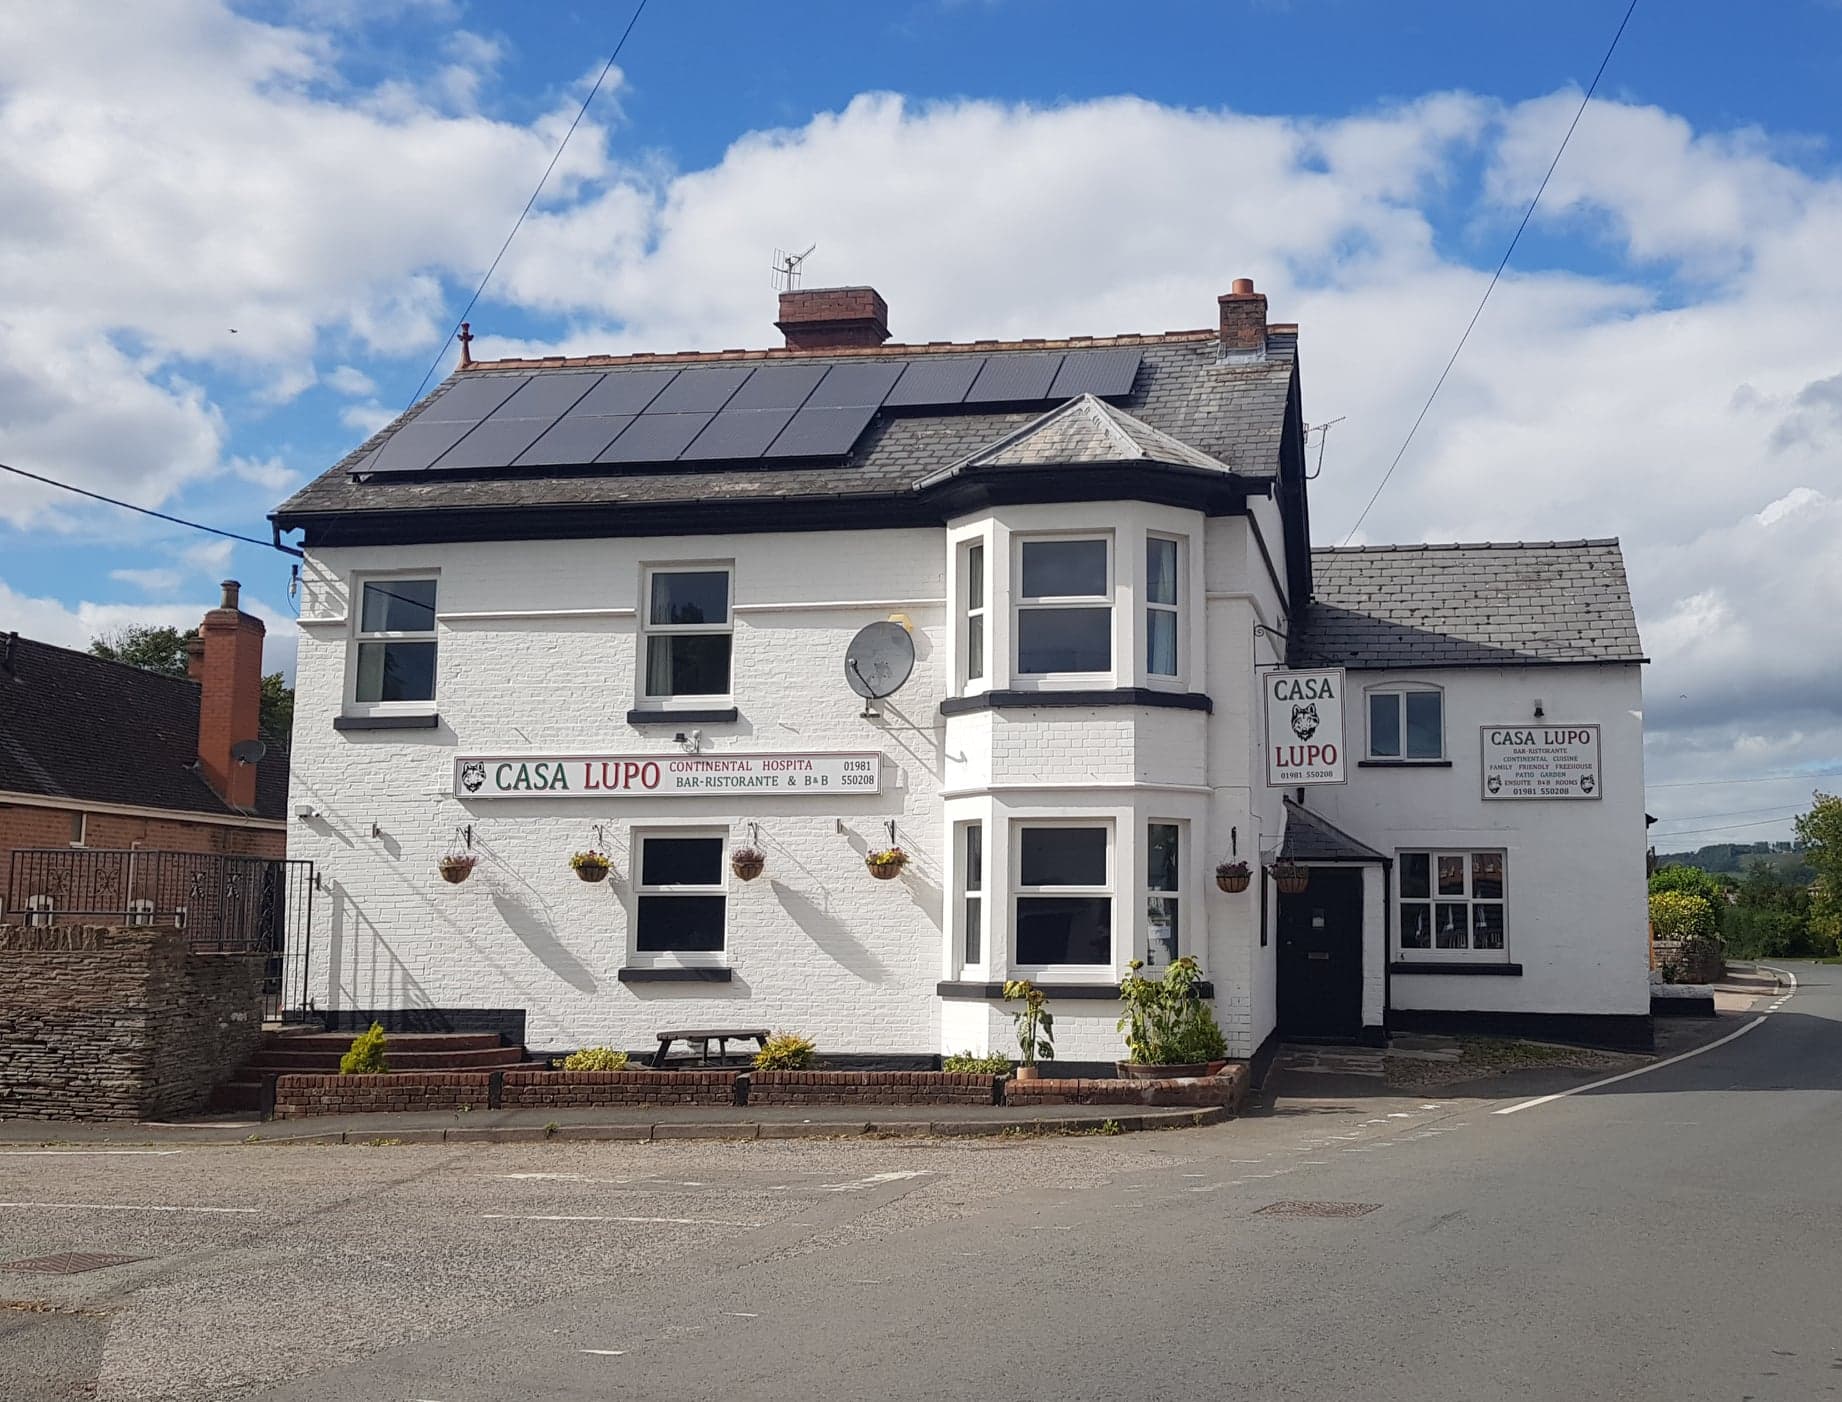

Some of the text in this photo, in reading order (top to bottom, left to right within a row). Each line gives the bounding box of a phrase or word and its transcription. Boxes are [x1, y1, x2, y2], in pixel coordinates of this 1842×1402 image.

[1274, 678, 1335, 701] CASA
[1491, 730, 1590, 745] CASA LUPO
[1275, 744, 1337, 767] LUPO
[669, 760, 813, 772] CONTINENTAL HOSPITA
[843, 761, 871, 771] 01981
[495, 762, 660, 791] CASA LUPO
[676, 776, 779, 788] BAR-RISTORANTE
[787, 775, 797, 786] &
[841, 775, 875, 785] 550208
